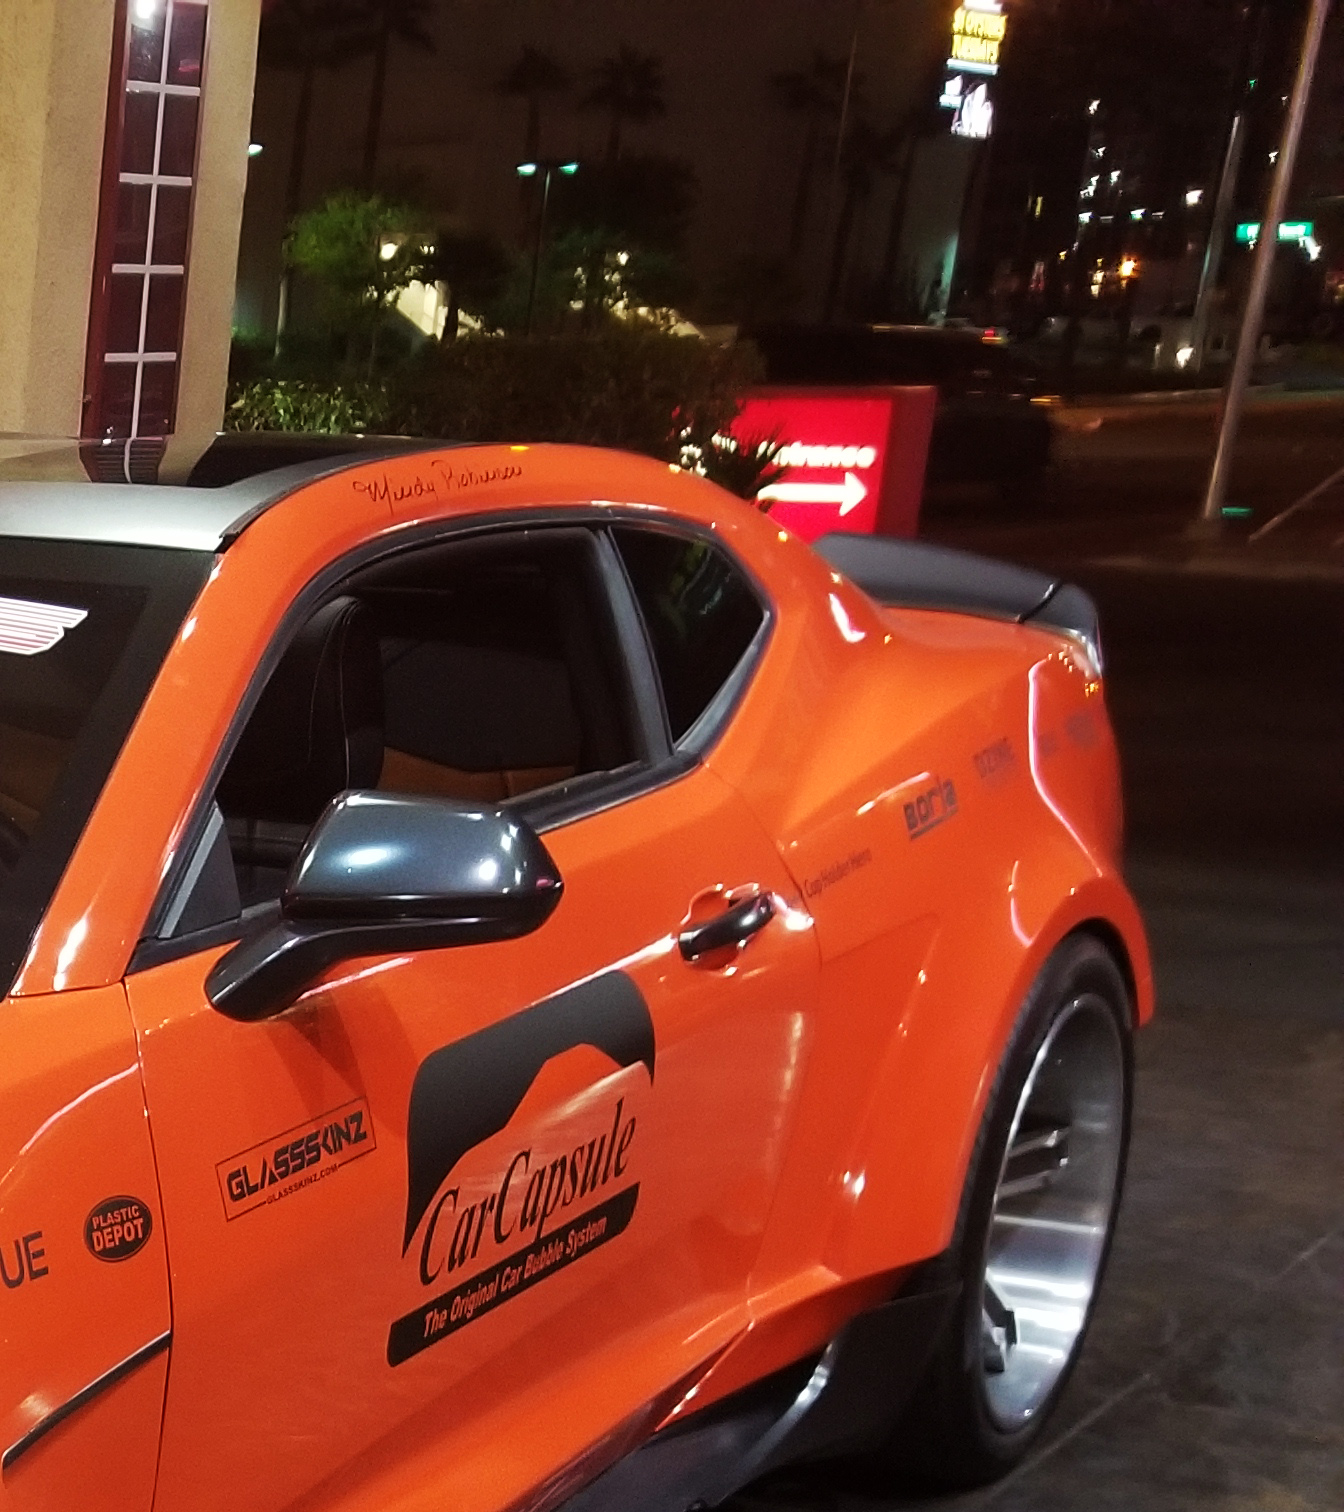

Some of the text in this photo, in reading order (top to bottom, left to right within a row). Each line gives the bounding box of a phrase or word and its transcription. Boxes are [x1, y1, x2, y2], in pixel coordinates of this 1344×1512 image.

[92, 1205, 140, 1229] PLASTIC
[419, 1096, 637, 1287] CarCapsule
[92, 1217, 144, 1252] DEPOT
[423, 1216, 608, 1338] The Original Car Bubble System
